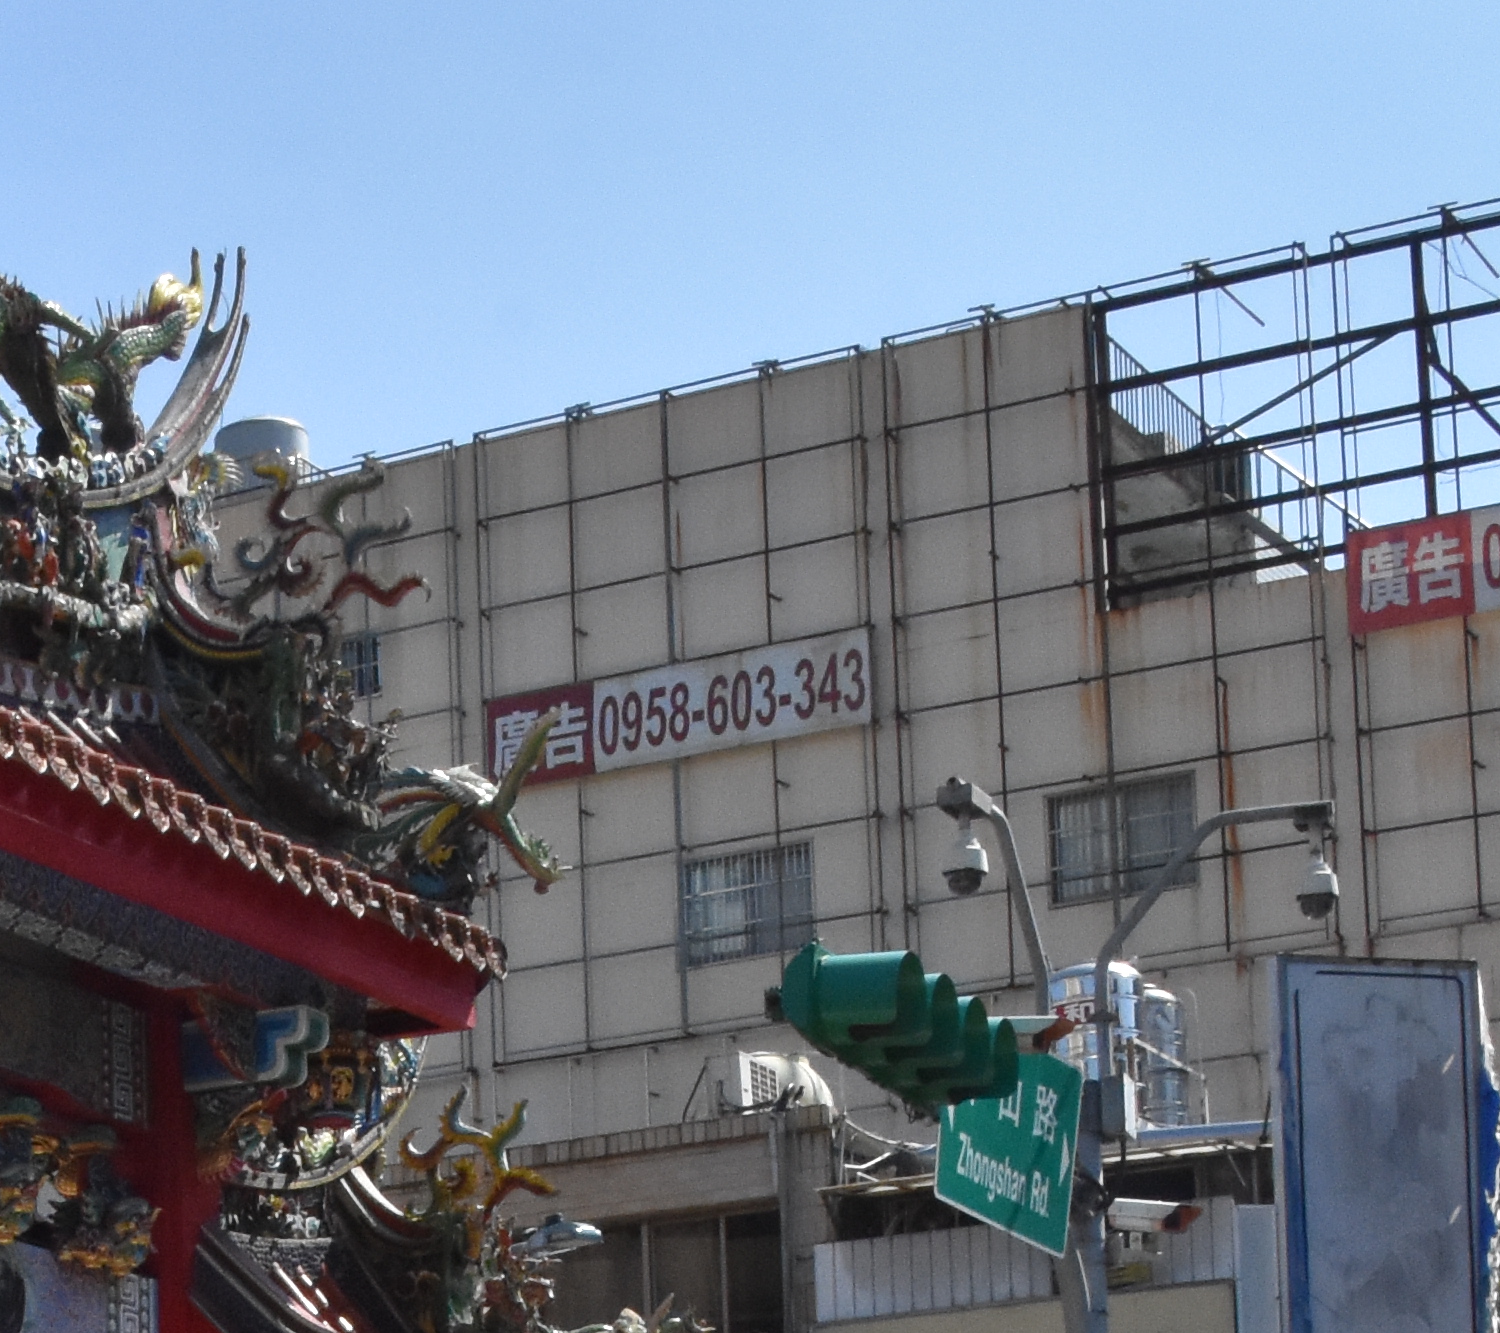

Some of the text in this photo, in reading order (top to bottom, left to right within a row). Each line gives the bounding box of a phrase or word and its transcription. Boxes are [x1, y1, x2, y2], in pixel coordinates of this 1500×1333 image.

[1360, 531, 1465, 613] 廣告
[599, 648, 866, 756] 0958-603-343
[956, 1132, 1050, 1218] Zhongshan Rd.
